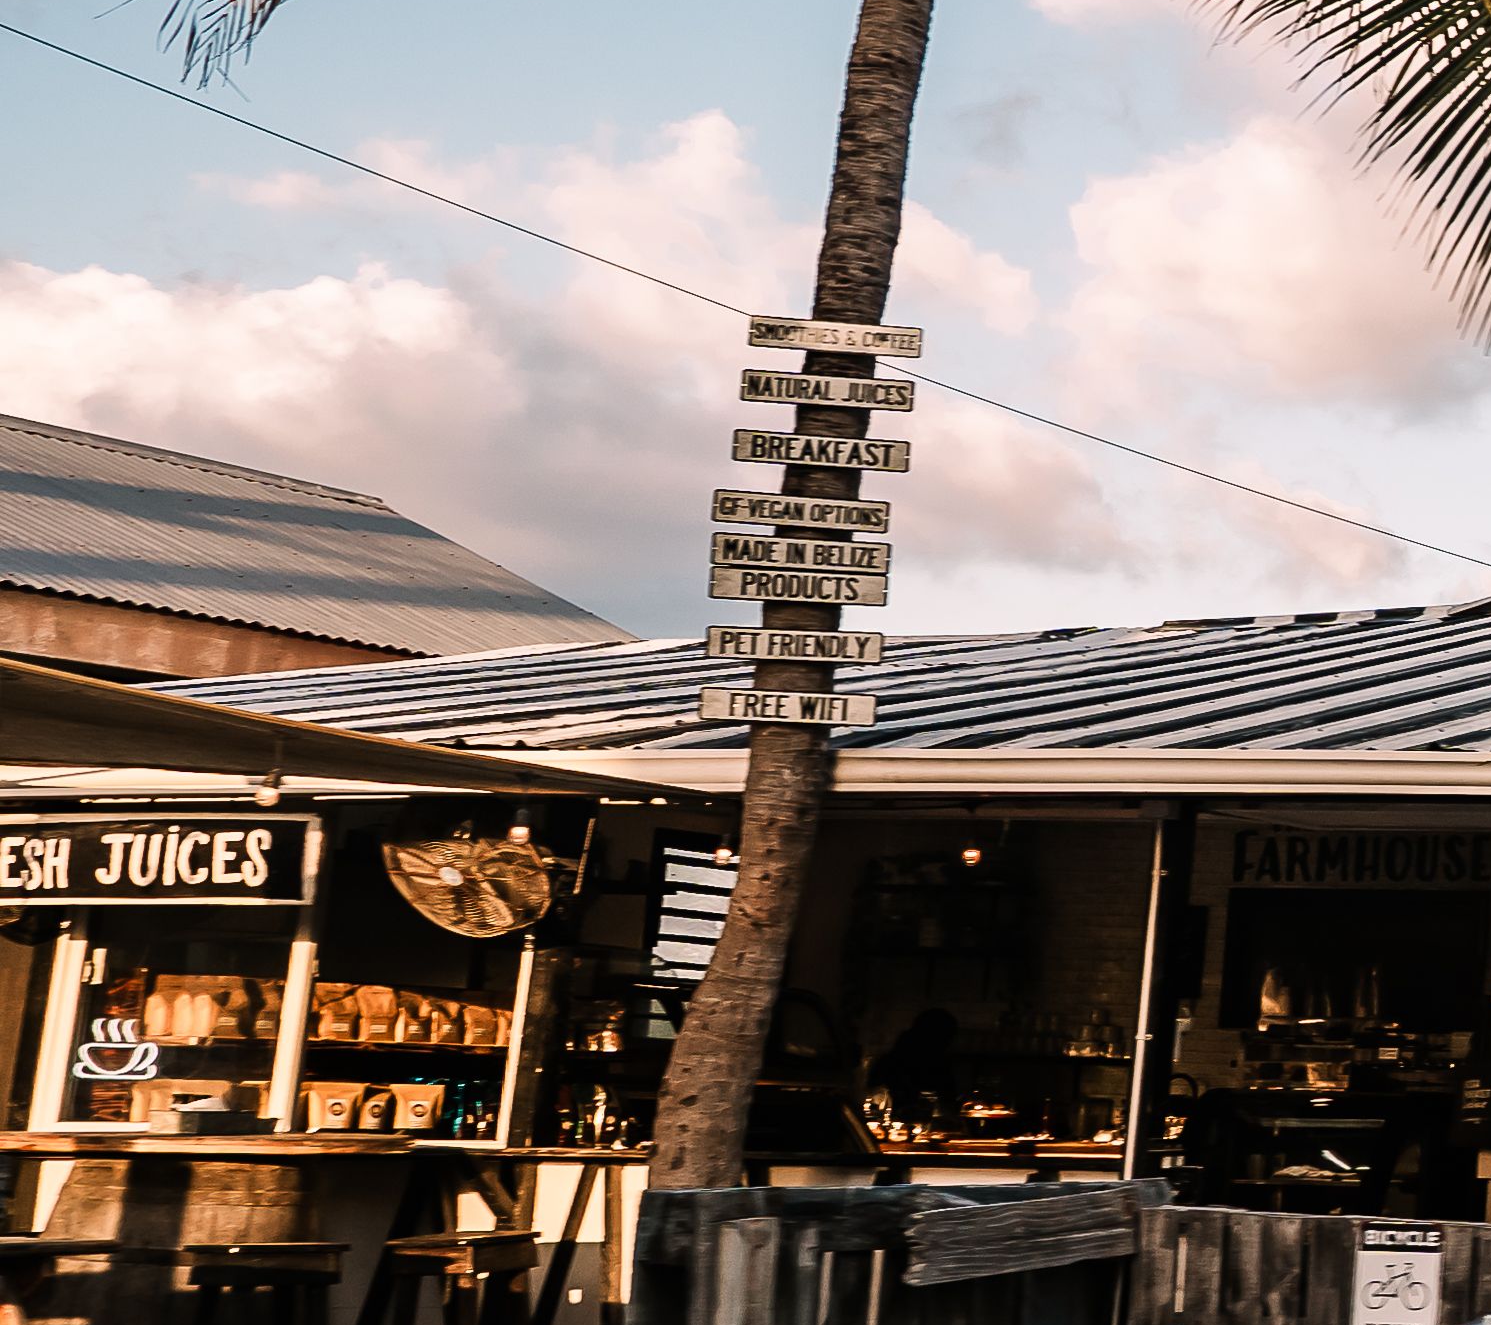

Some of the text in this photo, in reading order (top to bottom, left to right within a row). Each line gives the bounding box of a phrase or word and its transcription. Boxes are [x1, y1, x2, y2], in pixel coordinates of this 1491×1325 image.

[753, 322, 917, 350] SMOOTHIES & COFFEE
[746, 375, 909, 406] NATURAL JUICES
[751, 434, 896, 468] BREAKFAST
[810, 504, 884, 526] OPTIONS
[722, 538, 881, 568] MADE IN BELIZE
[740, 572, 860, 601] PRODUCTS
[719, 631, 871, 659] PET FRIENDLY
[729, 692, 849, 721] FREE WIFI
[0, 835, 72, 891] ESH
[1364, 1229, 1441, 1246] BICYCLE
